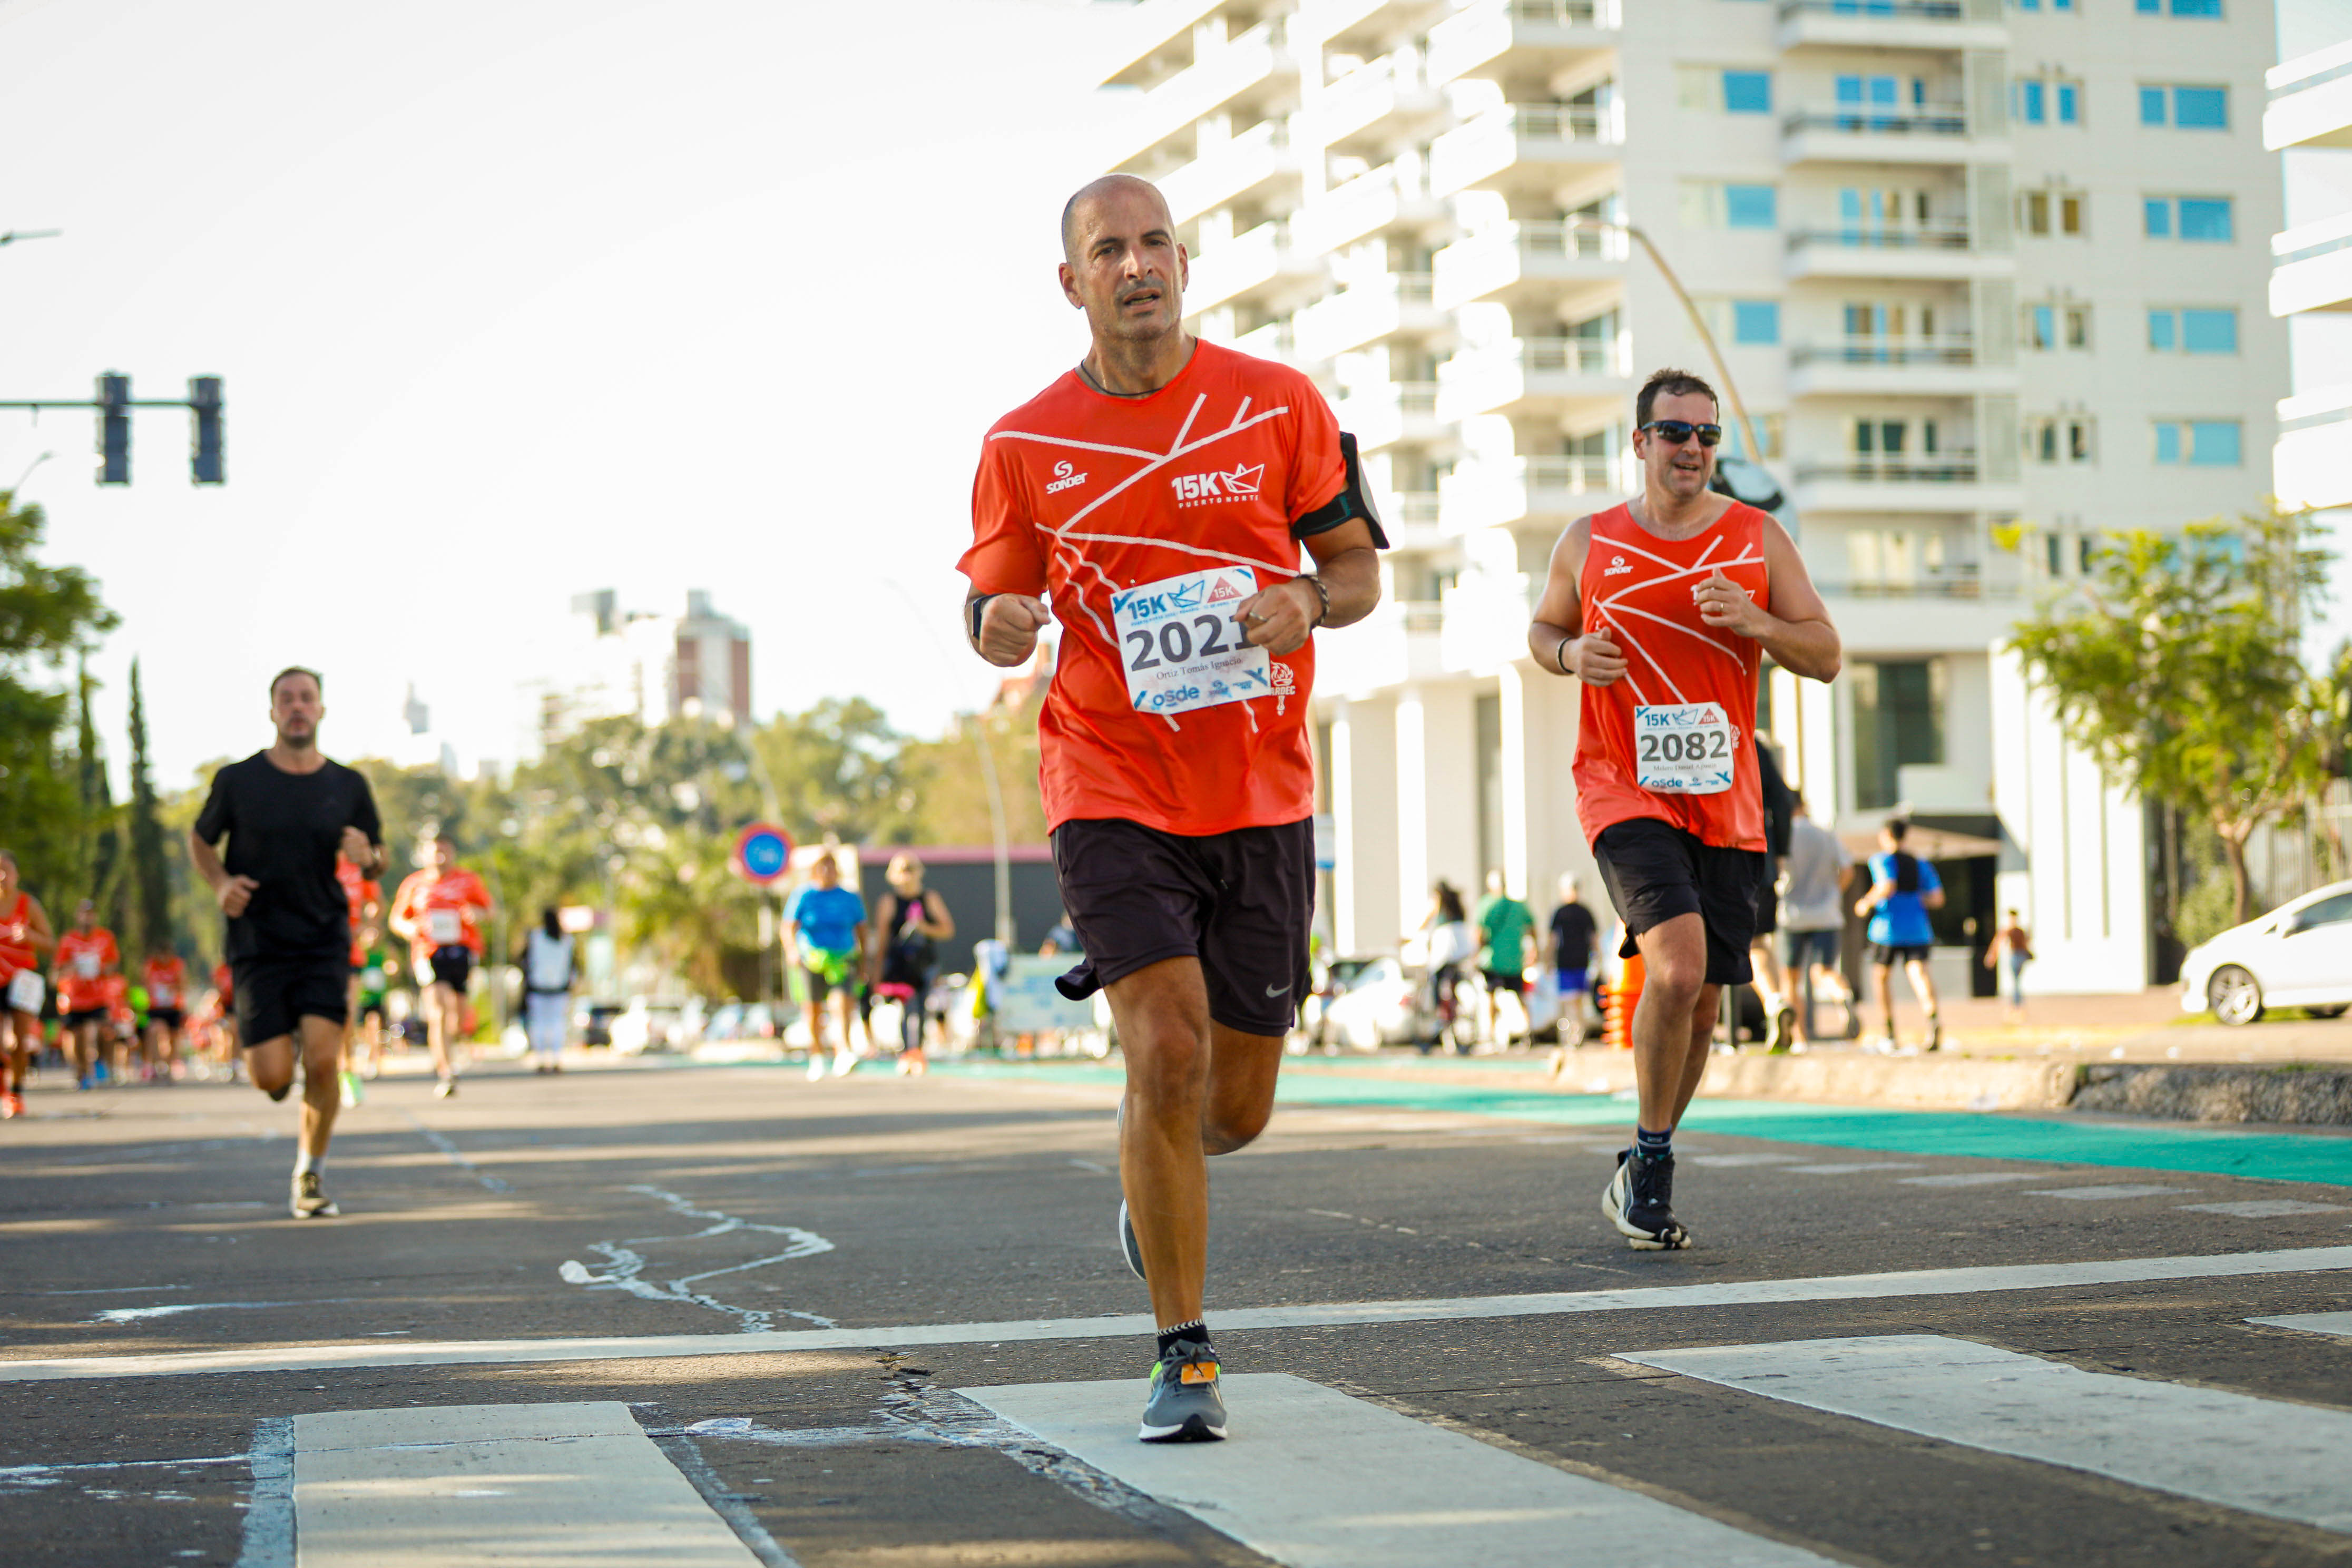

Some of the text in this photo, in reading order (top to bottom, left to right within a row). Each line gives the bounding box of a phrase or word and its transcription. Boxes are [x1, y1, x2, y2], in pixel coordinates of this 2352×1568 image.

[1171, 472, 1221, 501] 15K
[1178, 497, 1222, 509] PUERTO
[1213, 586, 1235, 599] 15K
[1128, 593, 1167, 620] 15K
[1156, 670, 1179, 681] Ortiz
[1152, 684, 1200, 707] osde
[1644, 713, 1670, 726] 15K
[1641, 730, 1729, 762] 2082
[1652, 777, 1683, 787] osde
